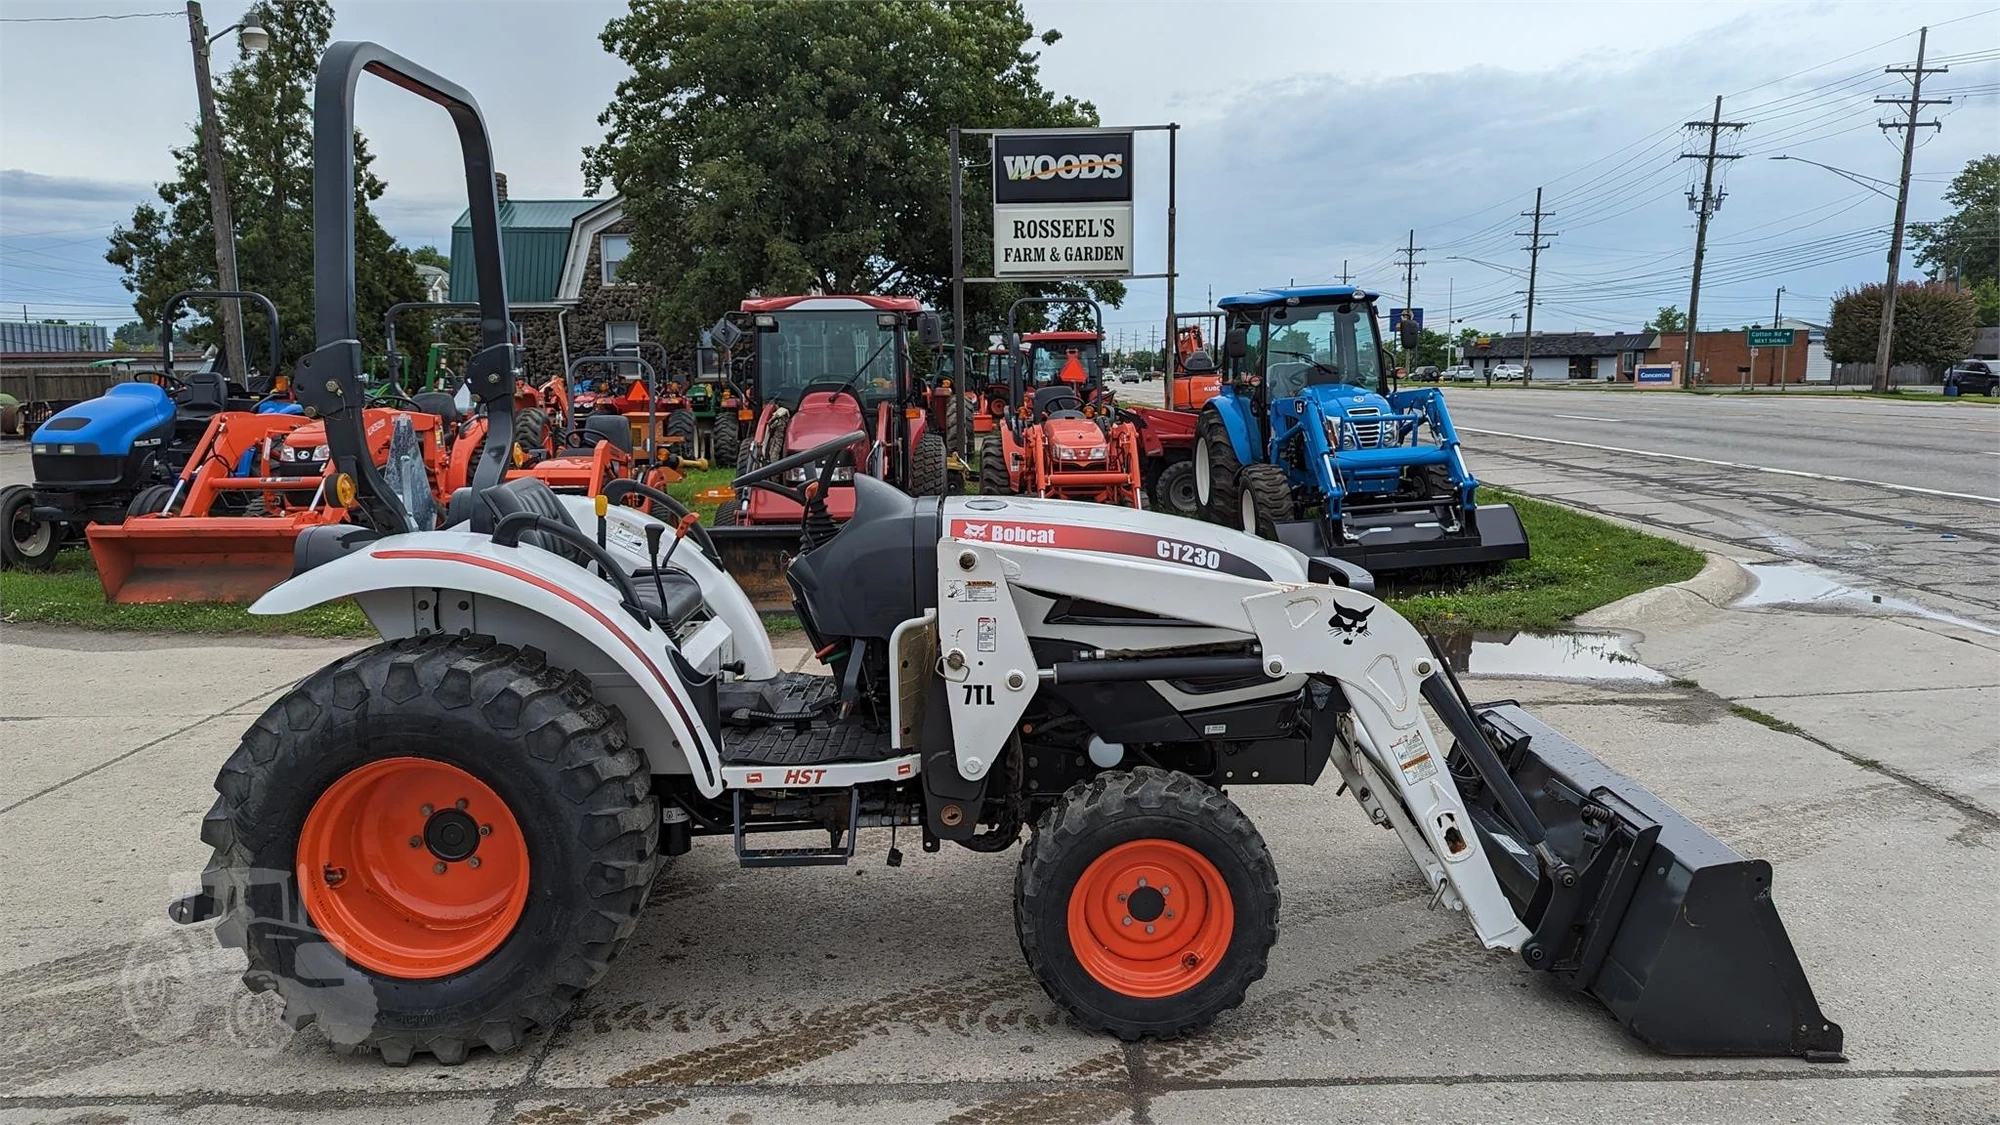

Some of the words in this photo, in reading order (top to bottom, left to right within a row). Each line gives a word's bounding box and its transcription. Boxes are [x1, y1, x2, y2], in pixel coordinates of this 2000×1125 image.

[1003, 153, 1123, 180] WOODS
[1013, 218, 1115, 239] ROSSEEL'S
[1004, 247, 1046, 262] FARM
[1050, 246, 1061, 262] &
[1064, 246, 1124, 261] GARDEN
[1296, 402, 1303, 414] LS
[991, 525, 1055, 544] Bobcat
[1156, 540, 1220, 569] CT230
[962, 684, 995, 705] 7TL
[784, 769, 827, 785] HST
